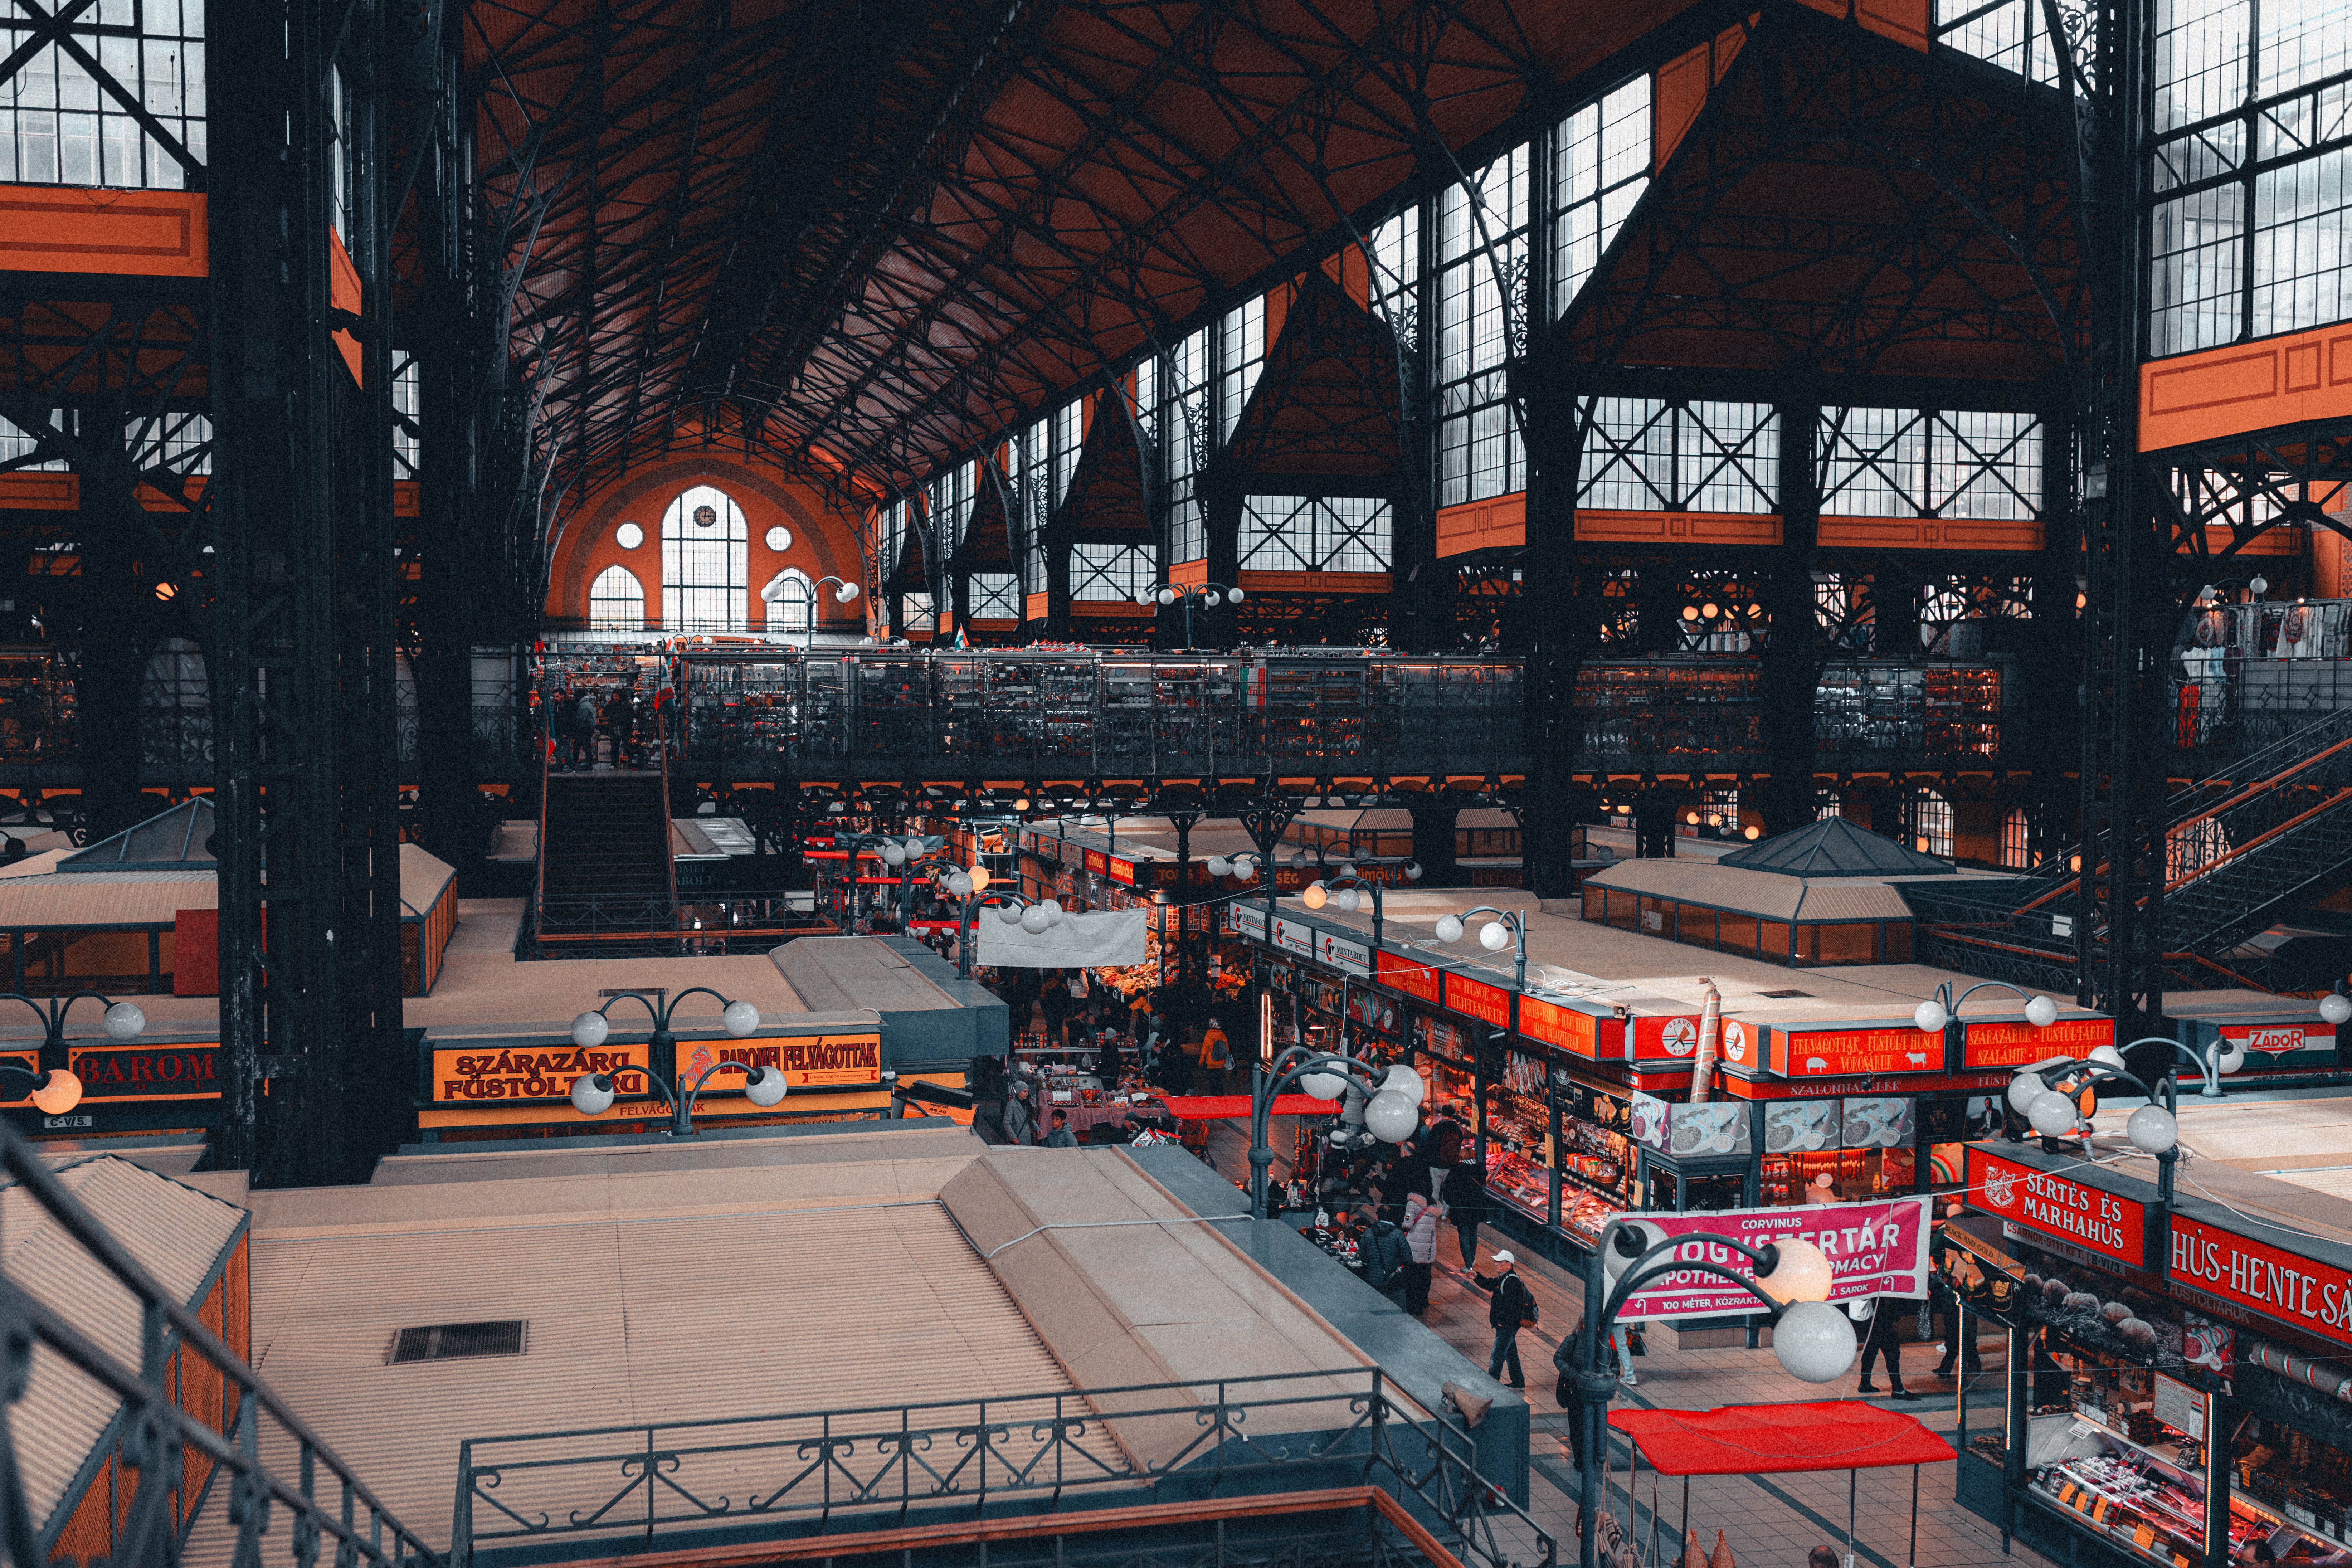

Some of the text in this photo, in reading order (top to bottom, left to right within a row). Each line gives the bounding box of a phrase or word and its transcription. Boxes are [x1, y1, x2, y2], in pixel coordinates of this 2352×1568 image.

[1336, 945, 1366, 963] MINTABOLT
[1464, 980, 1489, 1001] HUSOK
[1450, 994, 1505, 1025] HENTESÁRUK
[1793, 1034, 1860, 1055] FELVÁGOTTAK
[1868, 1030, 1907, 1052] FÜSTÖLT
[1968, 1025, 2032, 1046] SZÁRAZÁRUK
[455, 1048, 630, 1076] SZÁRAZÁRU
[784, 1037, 878, 1071] FELVÁGOTTAK
[1840, 1051, 1893, 1072] VÖRÖSÁRUK
[444, 1071, 642, 1100] FÜSTÖLTRU
[2026, 1173, 2122, 1222] SERTÉS ÉS
[1742, 1217, 1802, 1230] CORVINUS
[2023, 1196, 2124, 1250] MARHAHÚS
[1963, 1235, 1976, 1247] AND
[1977, 1243, 1994, 1258] GOLD
[1840, 1284, 1869, 1295] SAROK
[1663, 1301, 1679, 1310] 100
[1682, 1297, 1713, 1309] MÉTER,
